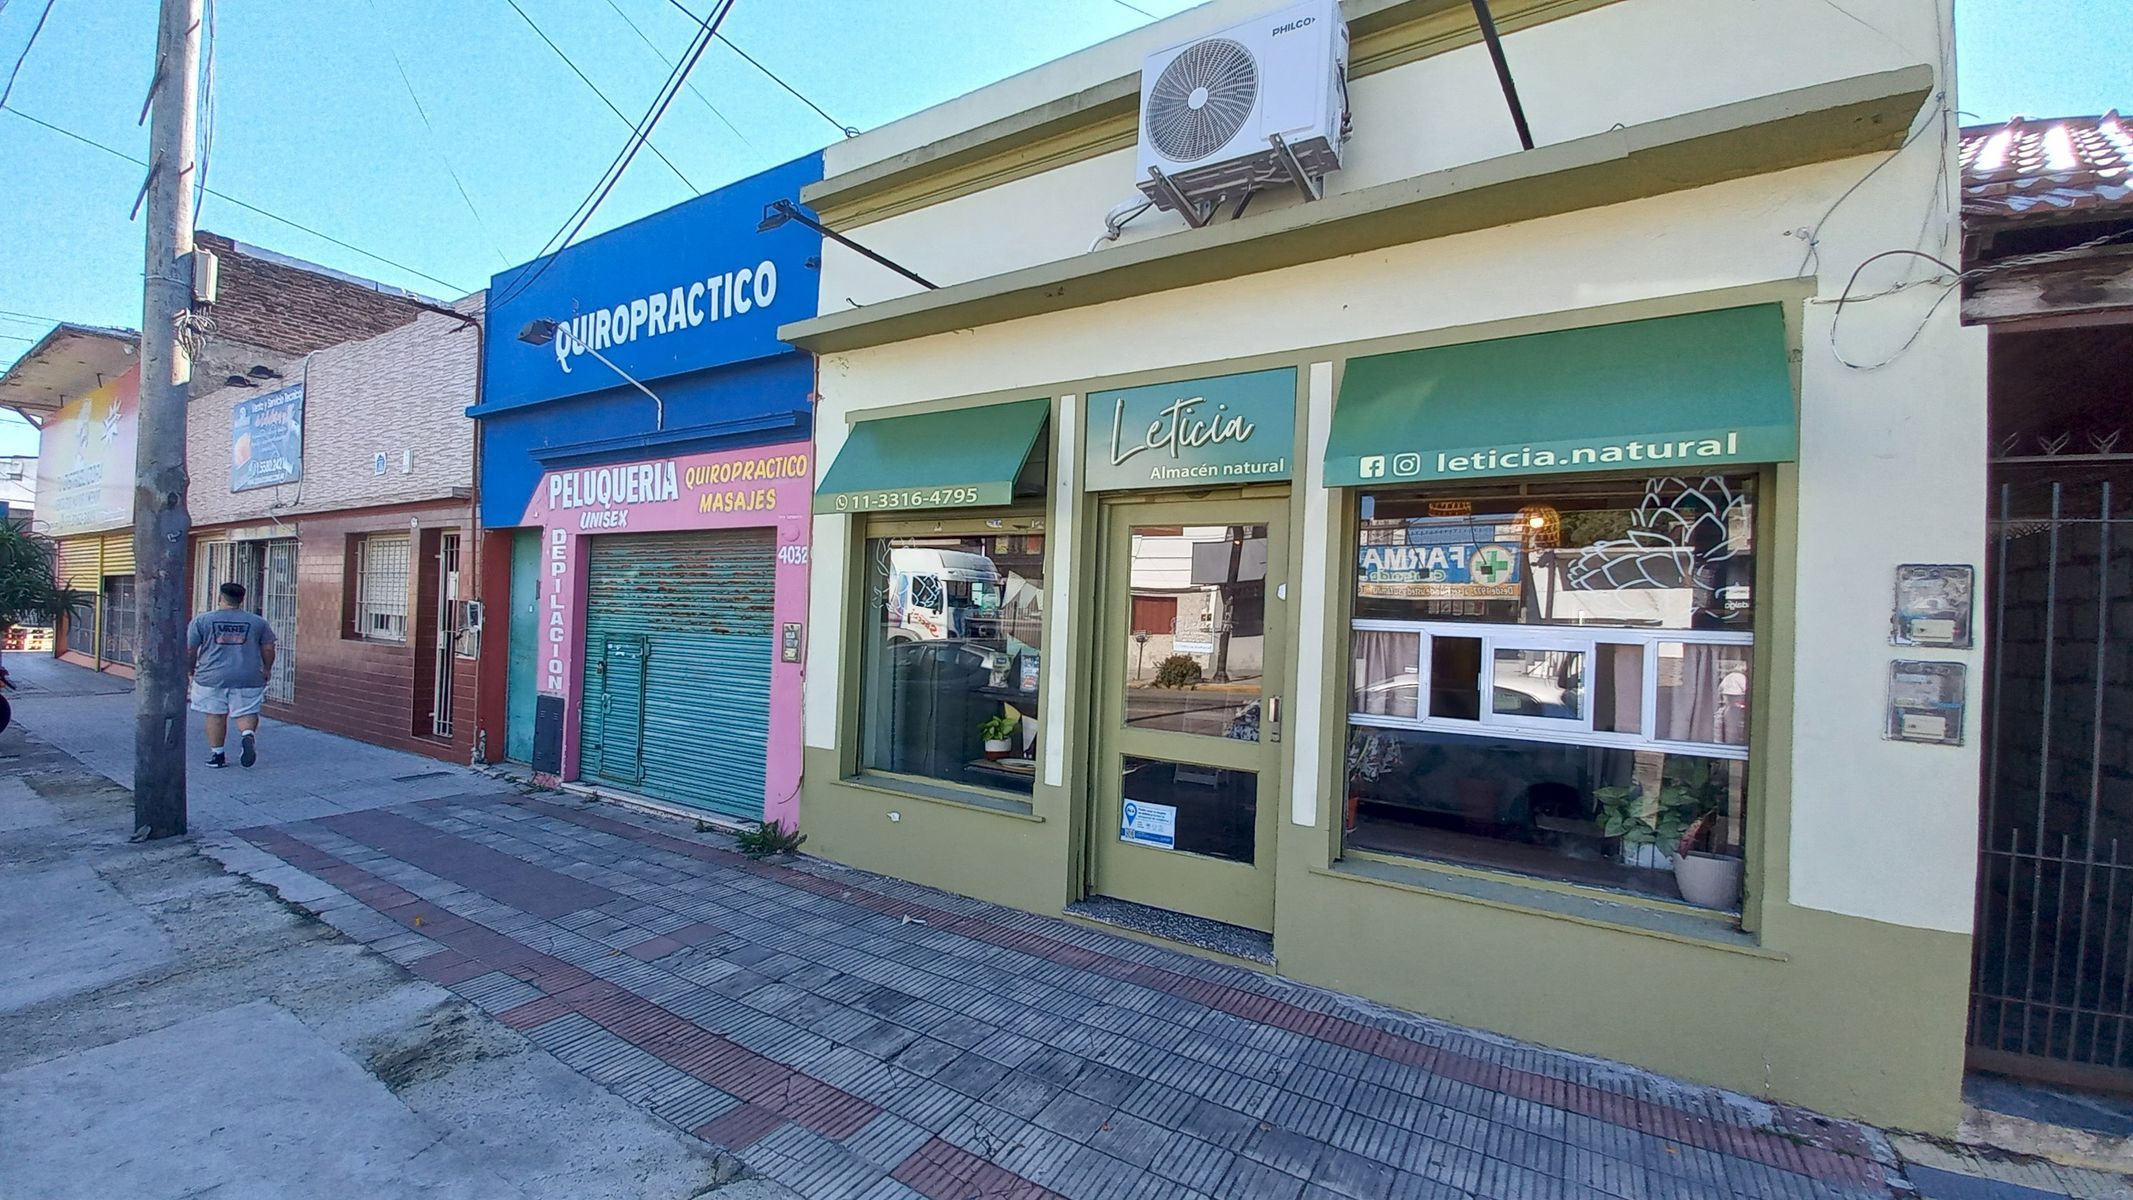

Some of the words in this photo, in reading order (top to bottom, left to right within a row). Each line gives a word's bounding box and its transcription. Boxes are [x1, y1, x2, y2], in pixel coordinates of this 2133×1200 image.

[1272, 17, 1312, 36] PHILCO
[554, 259, 778, 374] QUIROPRACTICO
[1110, 396, 1255, 466] Leticia
[1437, 431, 1738, 473] leticia.natural
[685, 454, 808, 489] QUIROPRACTICO
[1150, 462, 1218, 480] Almacén
[1223, 457, 1285, 476] natural
[549, 461, 680, 511] PELUQUERIA
[698, 488, 777, 513] MASAJES
[852, 487, 977, 510] 11-3316-4795
[580, 509, 629, 530] UNISEX
[778, 545, 808, 565] 4032
[548, 528, 567, 690] DEPILACION
